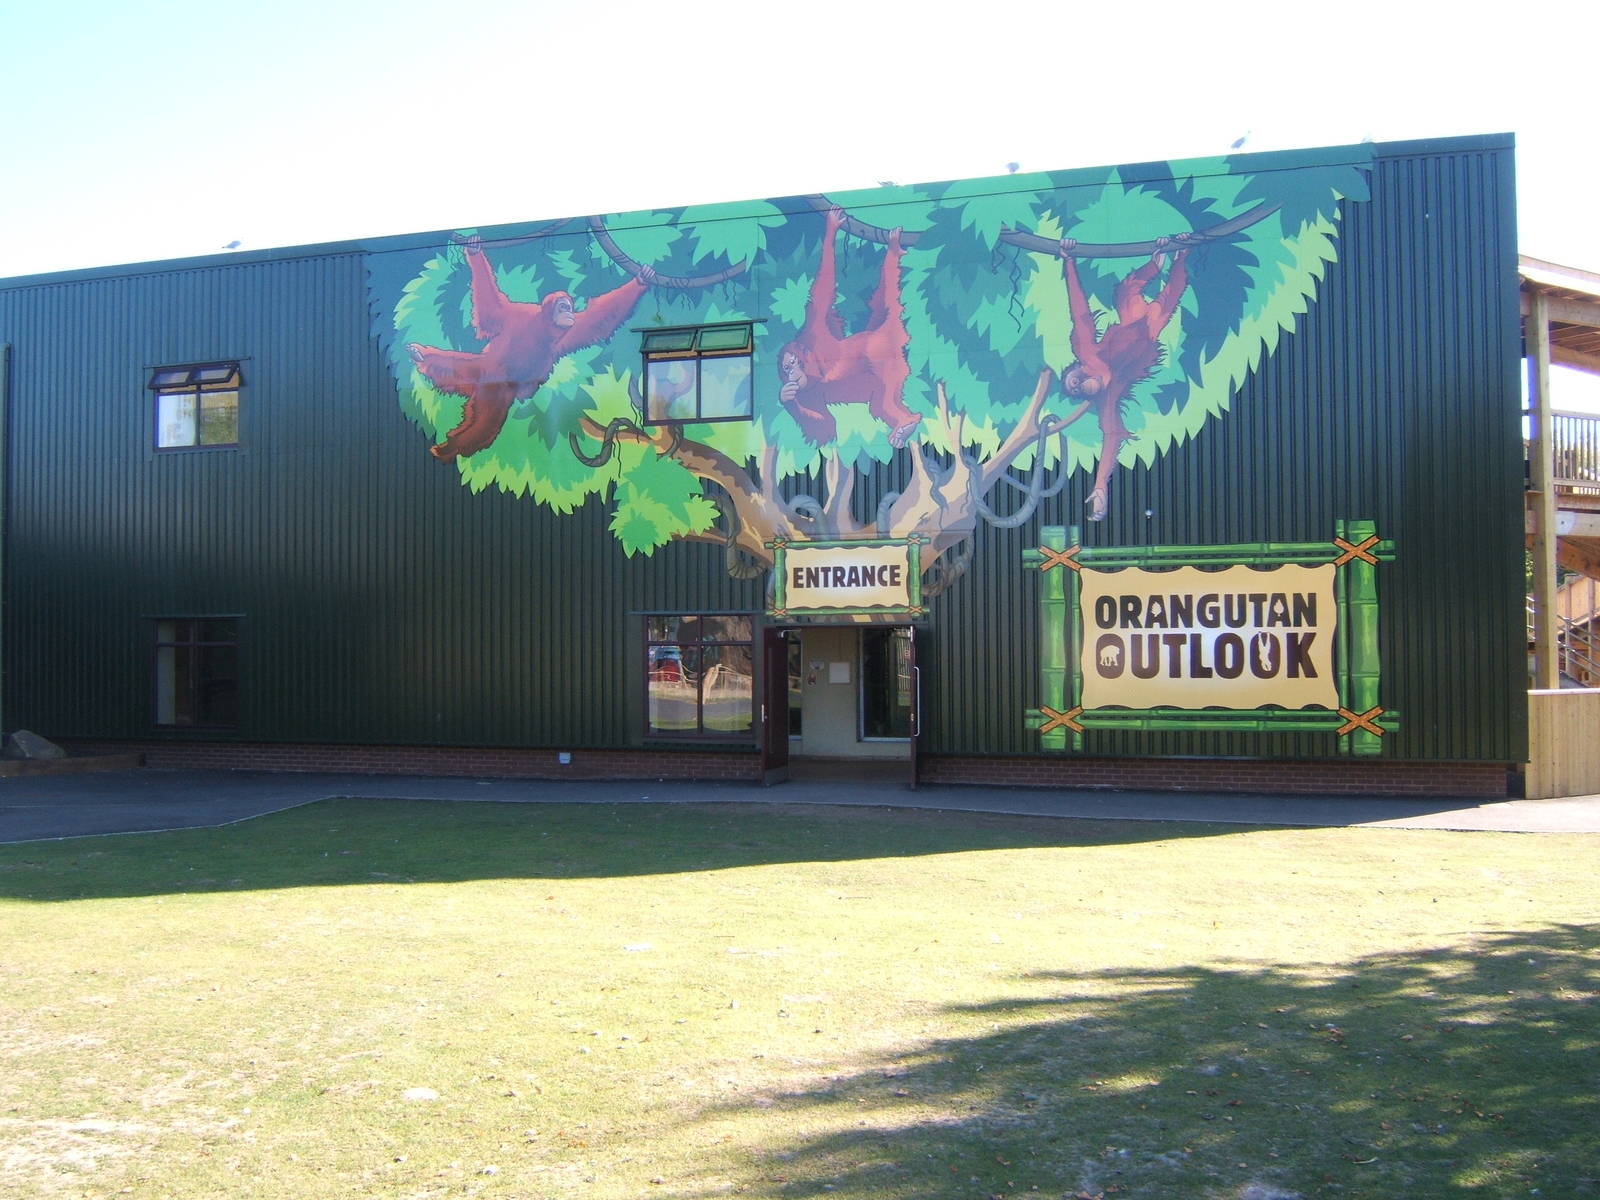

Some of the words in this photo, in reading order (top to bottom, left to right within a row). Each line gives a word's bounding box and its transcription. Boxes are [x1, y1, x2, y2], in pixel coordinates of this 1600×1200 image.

[793, 565, 901, 588] ENTRANCE
[1095, 593, 1317, 629] ORANGUTAN
[1096, 632, 1318, 679] OUTLOOK
